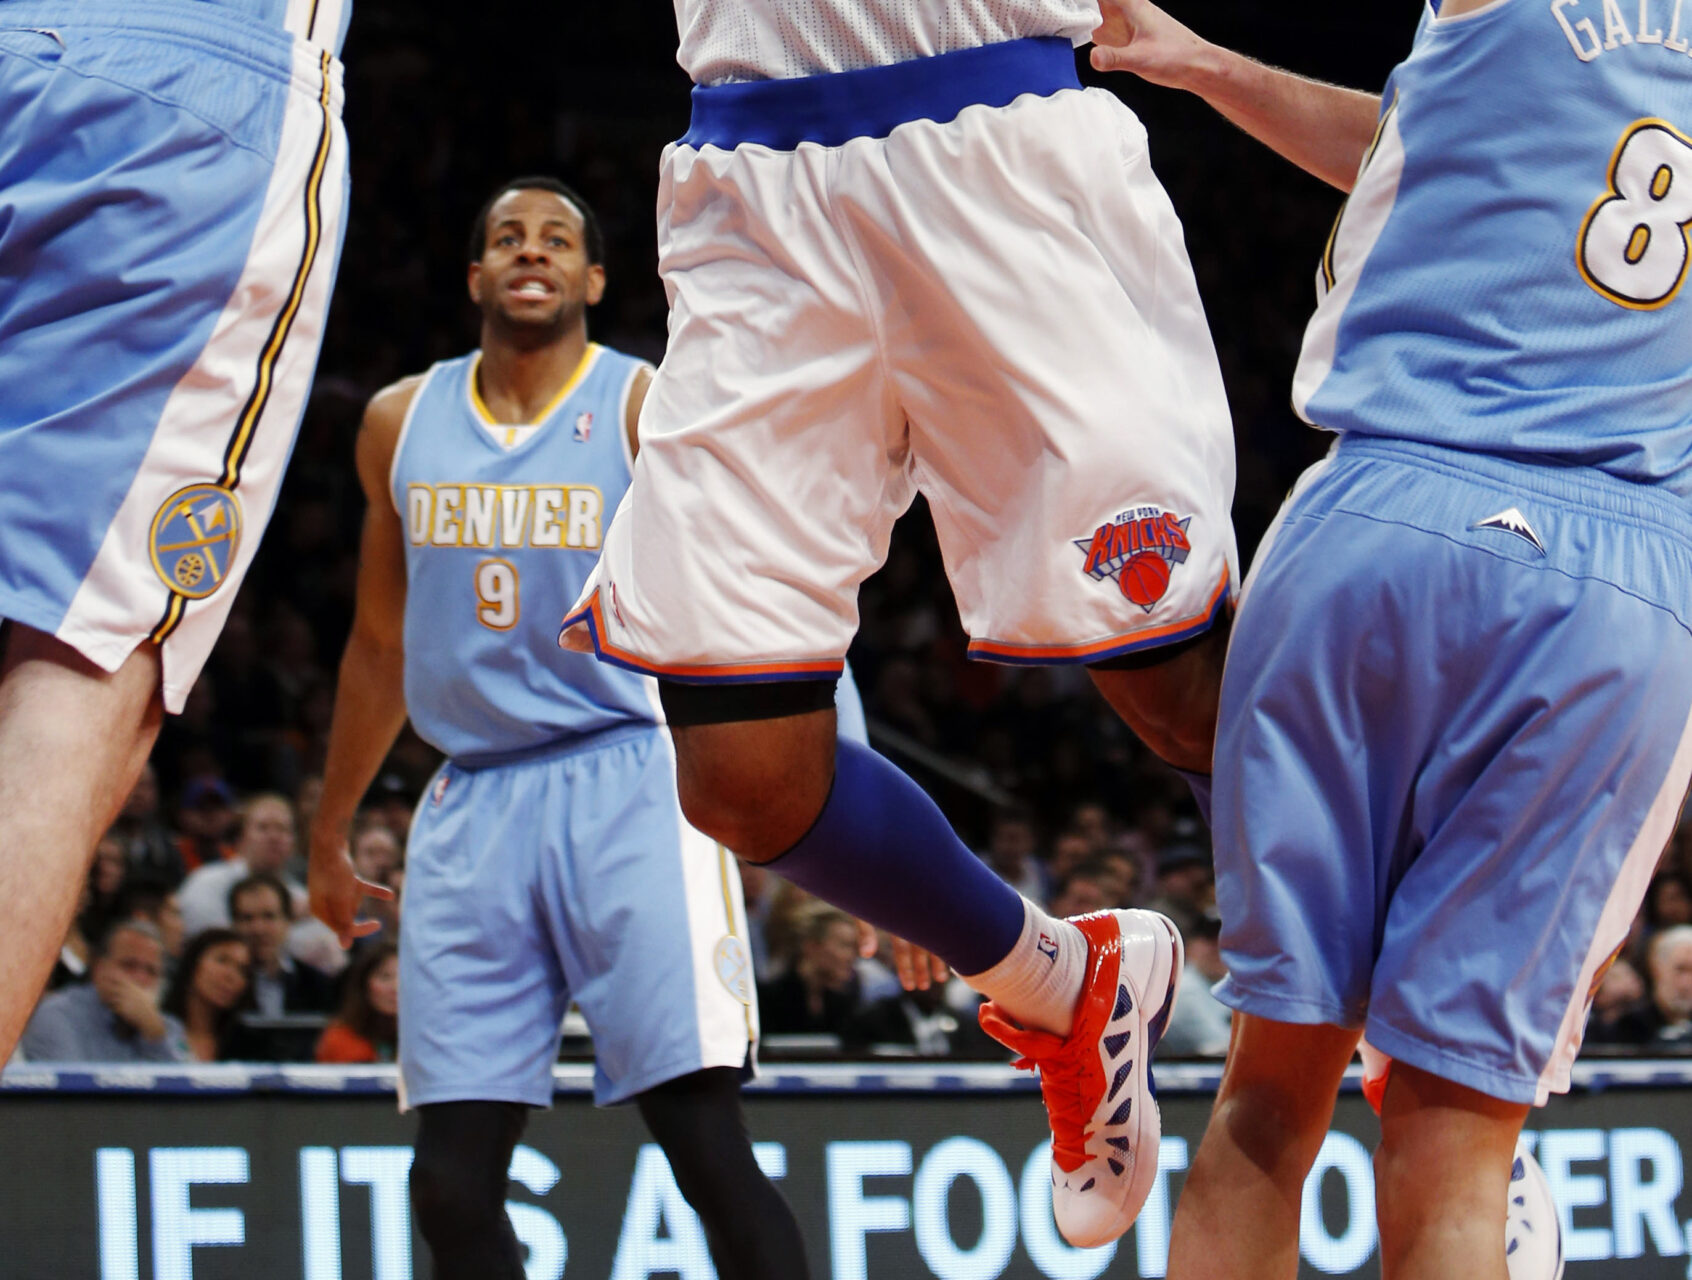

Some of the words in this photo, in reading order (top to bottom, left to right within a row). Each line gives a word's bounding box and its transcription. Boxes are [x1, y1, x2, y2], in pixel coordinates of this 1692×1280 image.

[1575, 118, 1692, 311] 8
[407, 483, 603, 551] DENVER
[1083, 512, 1191, 574] KNICKS
[1115, 509, 1135, 524] NEW
[1137, 507, 1160, 518] YORK
[474, 557, 520, 632] 9
[95, 1146, 251, 1280] IF
